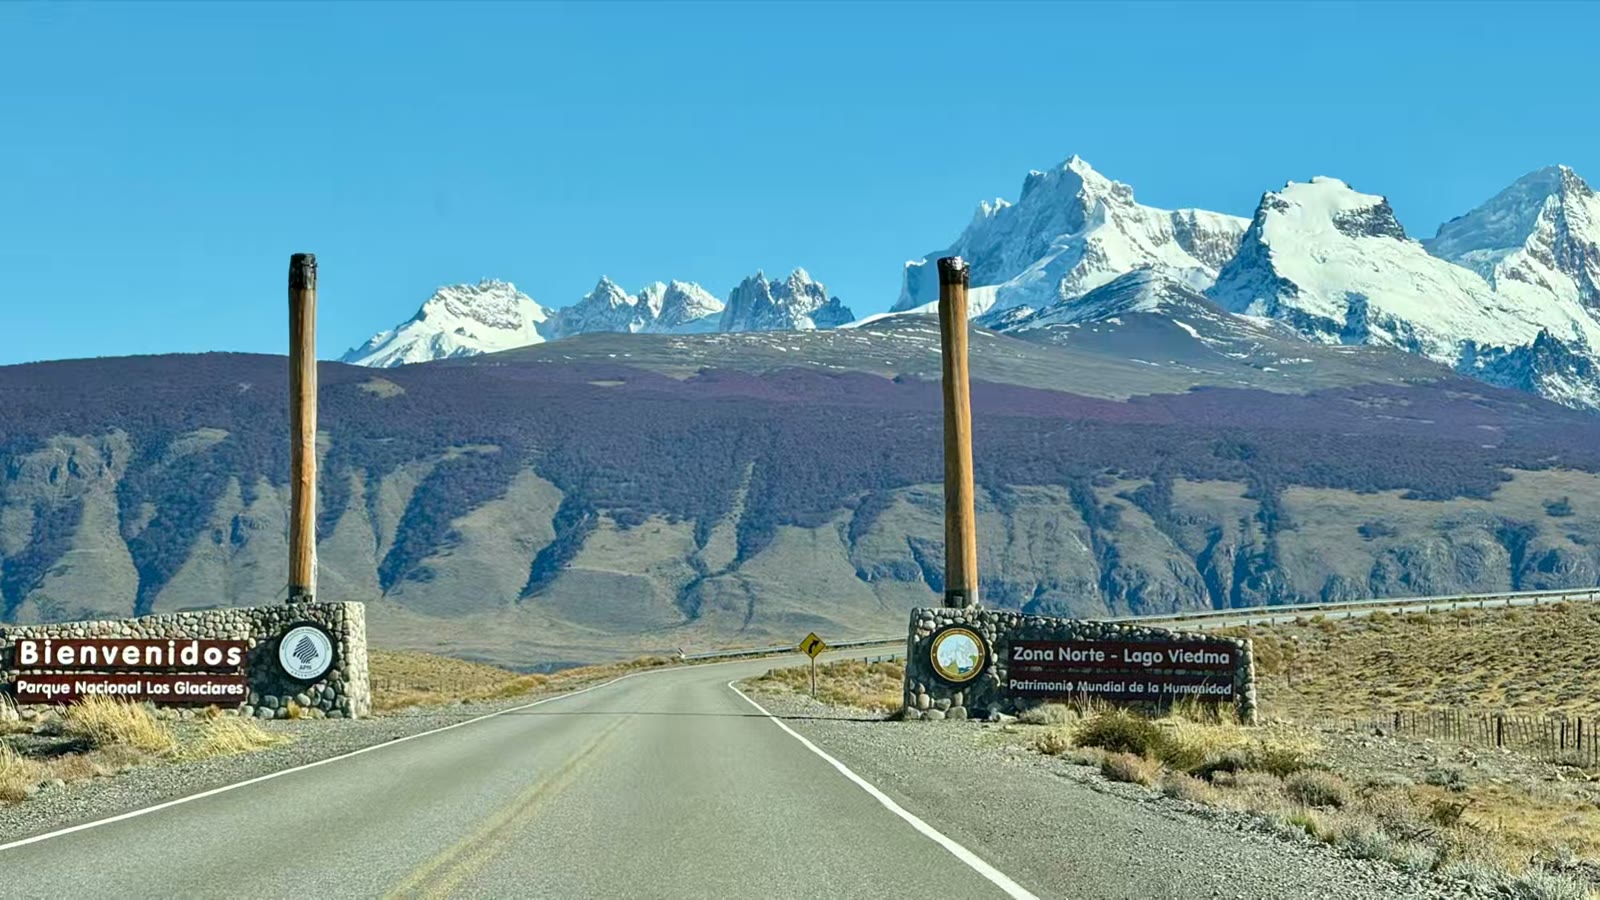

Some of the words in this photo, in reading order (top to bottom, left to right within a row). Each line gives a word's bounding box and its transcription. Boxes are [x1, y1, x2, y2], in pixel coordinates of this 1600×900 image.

[20, 639, 242, 666] Bienvenidos
[1013, 646, 1054, 661] Zona
[1058, 647, 1105, 662] Norte
[1123, 648, 1164, 667] Lago
[1168, 649, 1230, 664] Viedma
[17, 680, 71, 699] Parque
[74, 680, 142, 694] Nacional
[146, 681, 170, 694] Los
[174, 681, 244, 695] Glaciares
[1009, 679, 1074, 691] Patrimonio
[1076, 681, 1125, 692] Mundial
[1128, 682, 1144, 692] de
[1147, 682, 1159, 693] la
[1163, 682, 1232, 694] Humanidad
